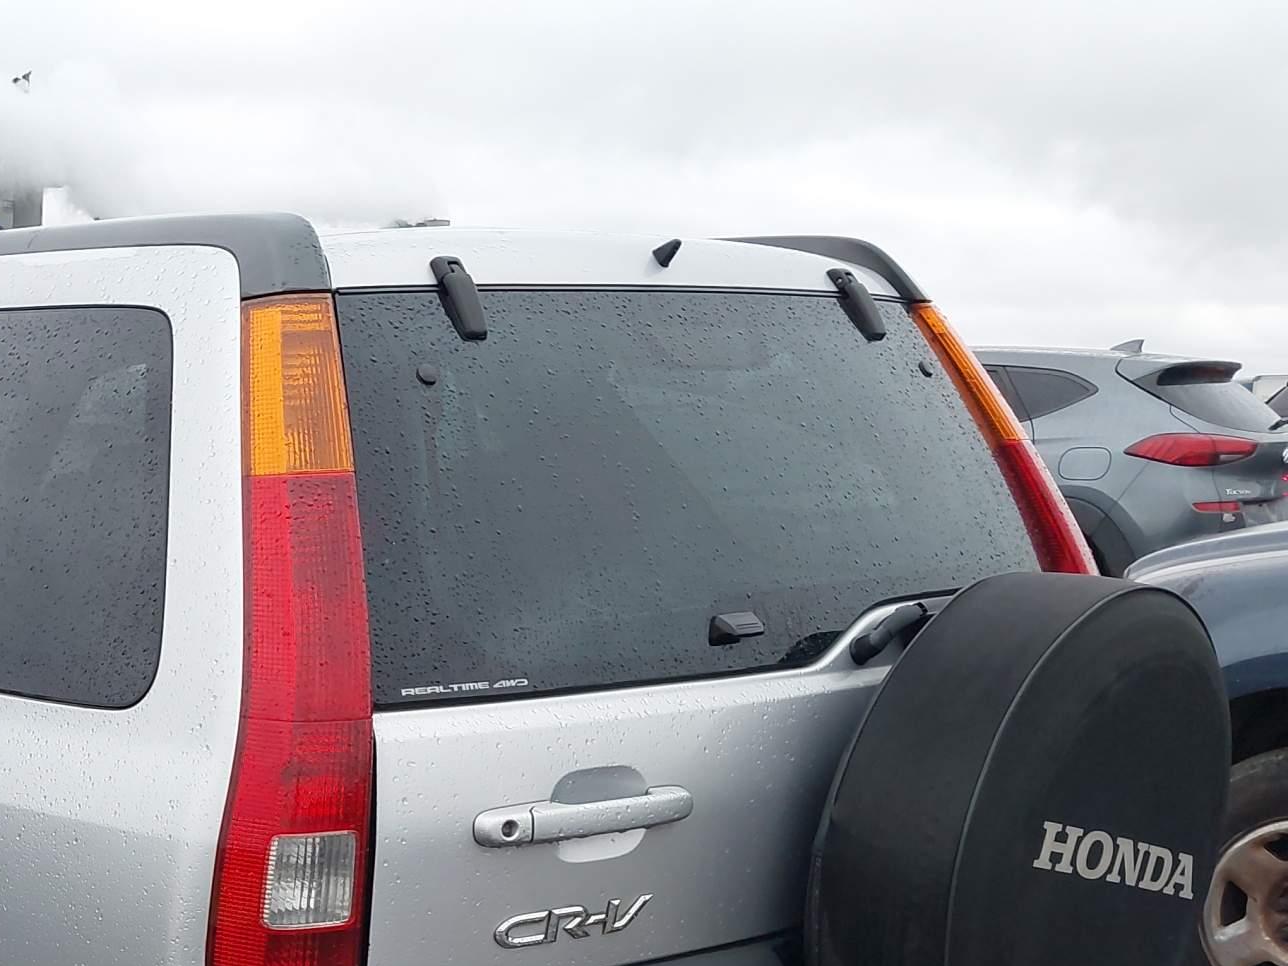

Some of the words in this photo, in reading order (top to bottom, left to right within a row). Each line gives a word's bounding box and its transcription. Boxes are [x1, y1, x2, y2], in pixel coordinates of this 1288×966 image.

[401, 681, 490, 696] REALTIME
[493, 678, 529, 689] 4WD
[1032, 820, 1195, 900] HONDA
[494, 893, 654, 949] CR-V
